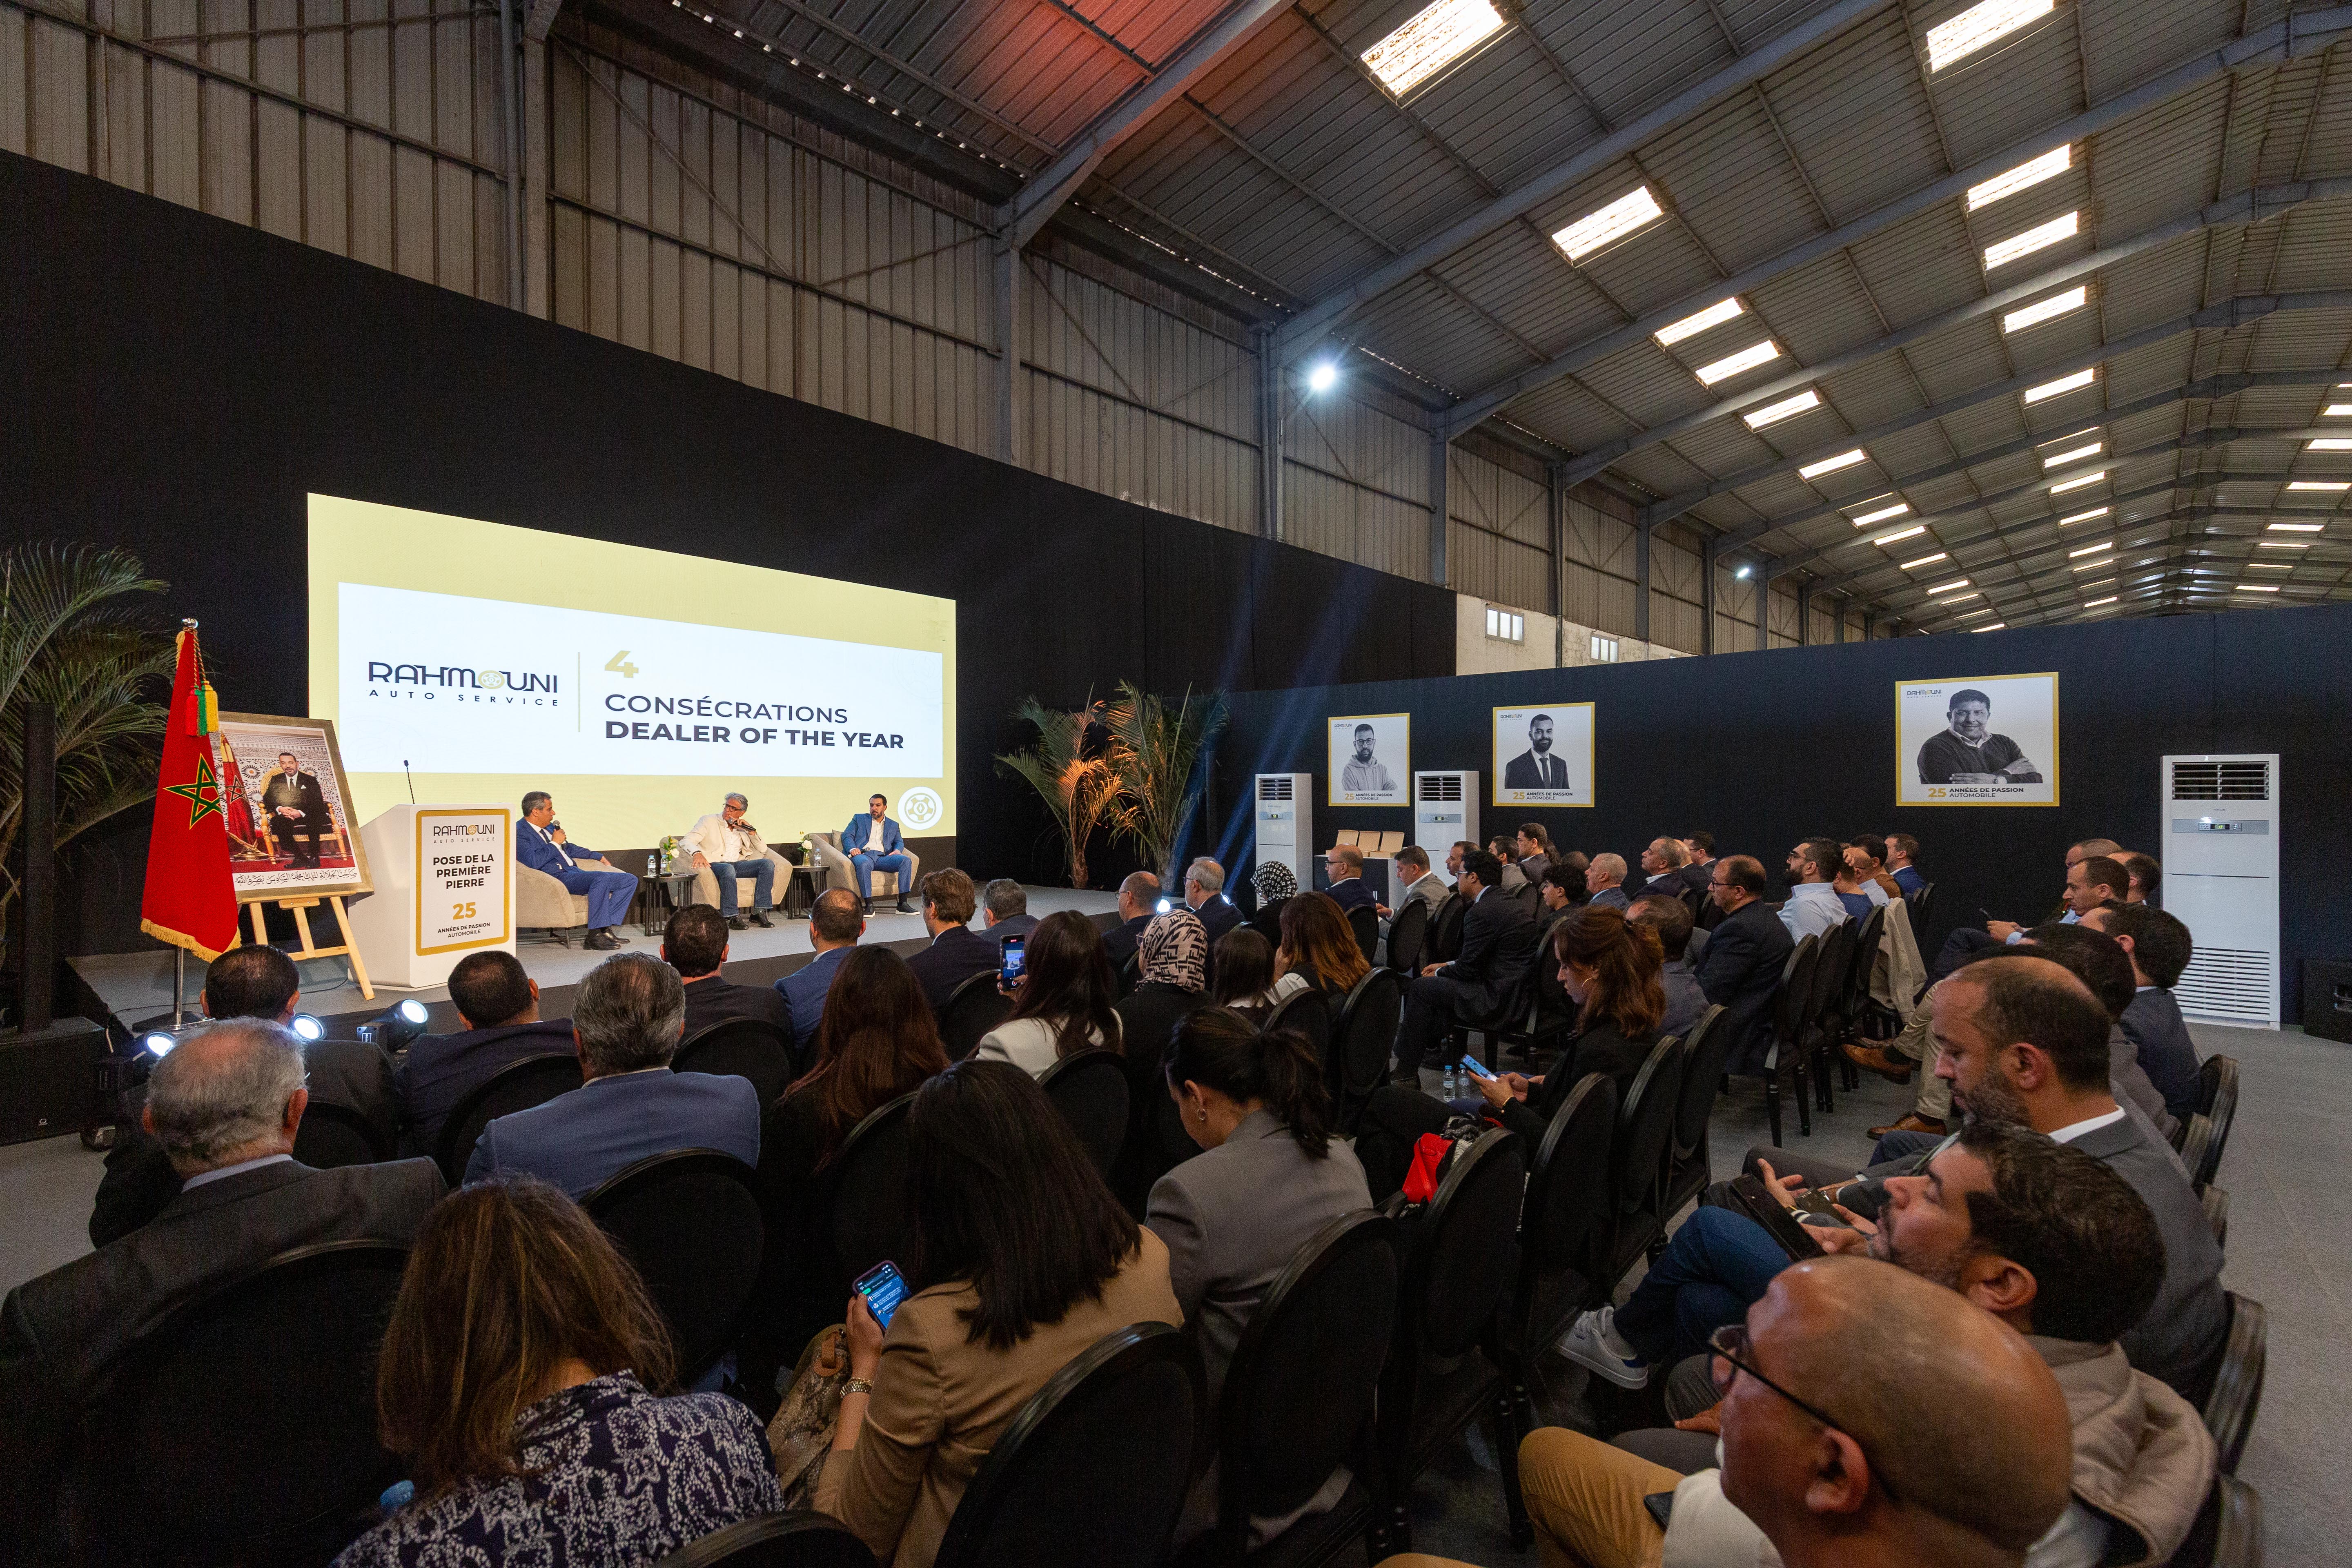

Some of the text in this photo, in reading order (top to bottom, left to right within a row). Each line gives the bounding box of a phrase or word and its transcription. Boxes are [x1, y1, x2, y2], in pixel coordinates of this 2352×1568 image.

[604, 650, 639, 679] 4
[369, 661, 558, 693] RAHMOUNI
[369, 689, 558, 706] AUTO SERVICE
[605, 694, 848, 724] CONSÉCRATIONS
[605, 721, 904, 749] DEALER OF THE YEAR
[1928, 788, 1947, 798] 25
[433, 824, 494, 836] RAHMOUNI
[433, 854, 494, 866] POSE DE LA
[437, 865, 491, 878] PREMIÈRE
[446, 878, 484, 889] PIERRE
[452, 902, 477, 920] 25
[448, 929, 481, 938] AUTOMOBILE
